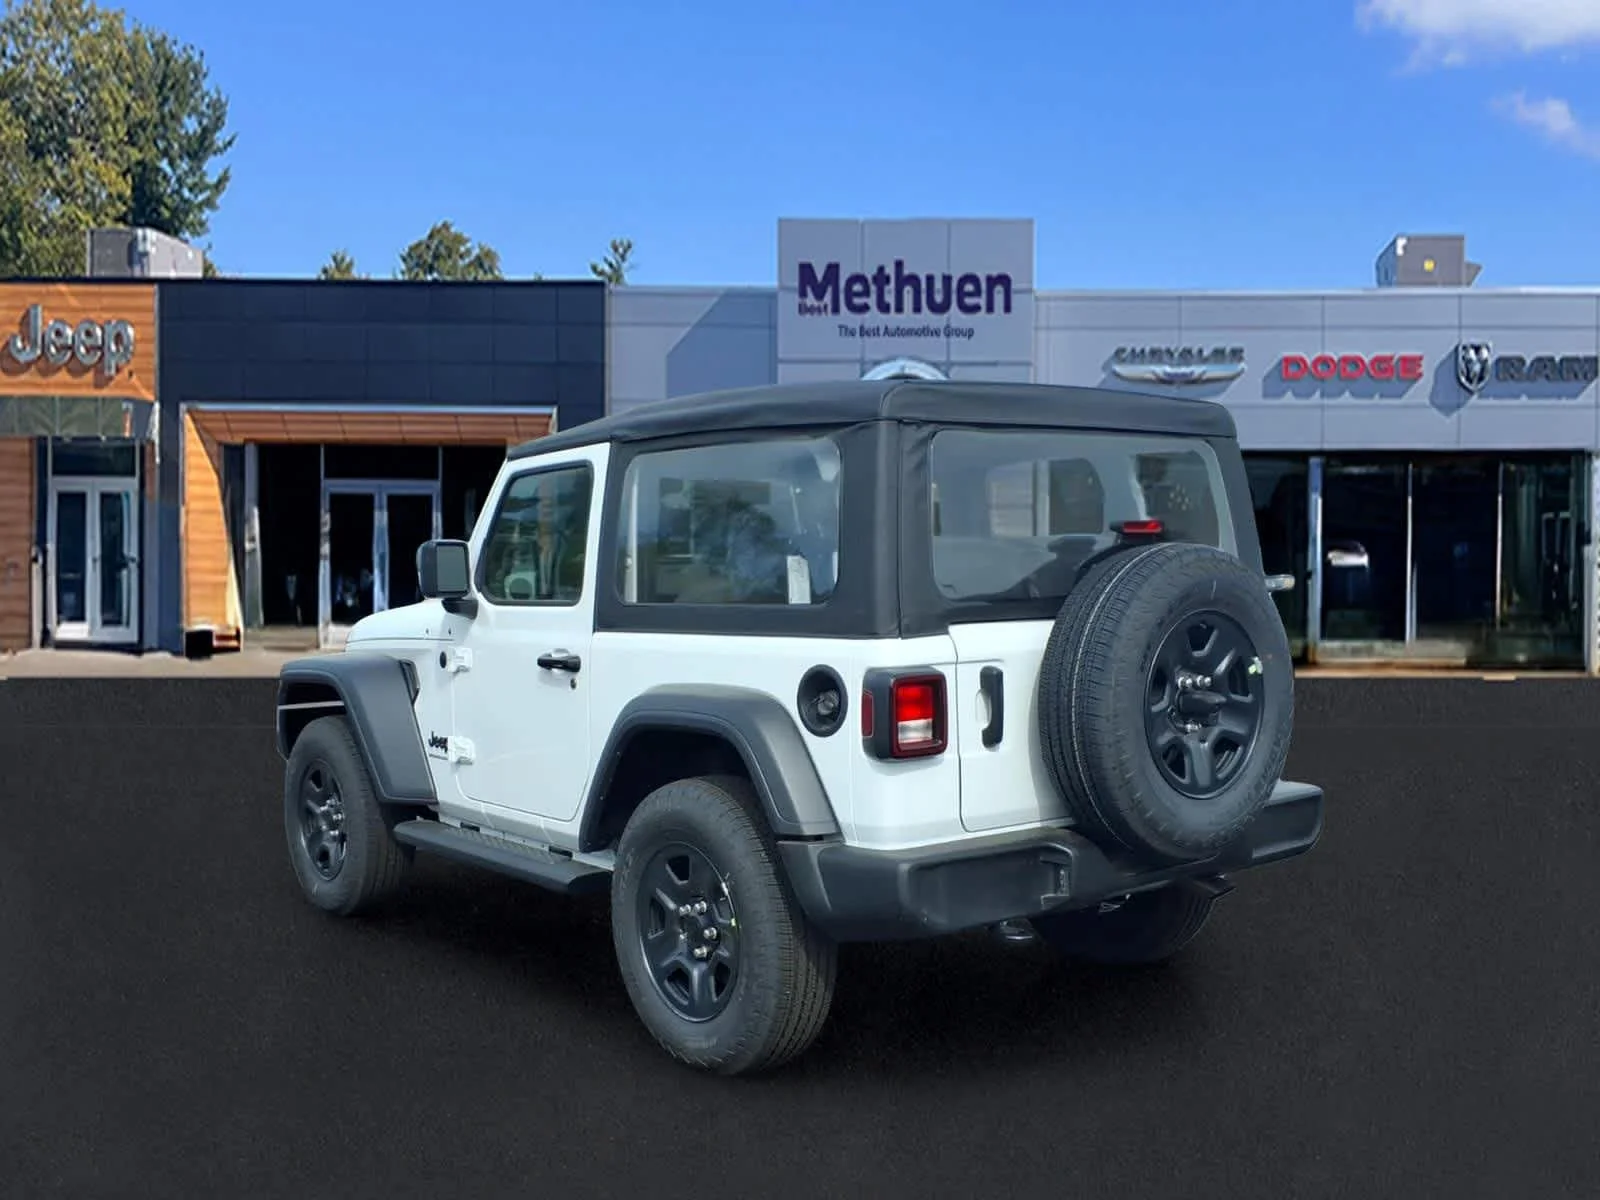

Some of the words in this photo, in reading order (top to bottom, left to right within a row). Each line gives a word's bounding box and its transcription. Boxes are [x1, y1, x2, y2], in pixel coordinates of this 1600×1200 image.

[798, 259, 1012, 315] Methuen
[9, 304, 135, 376] Jeep
[837, 324, 857, 338] The
[859, 324, 880, 338] Best
[882, 324, 941, 338] Automotive
[943, 324, 975, 341] Group
[1113, 345, 1245, 364] CHRYSLER
[1281, 353, 1424, 381] DODGE
[1495, 353, 1599, 382] RAM
[428, 731, 448, 754] Jeep
